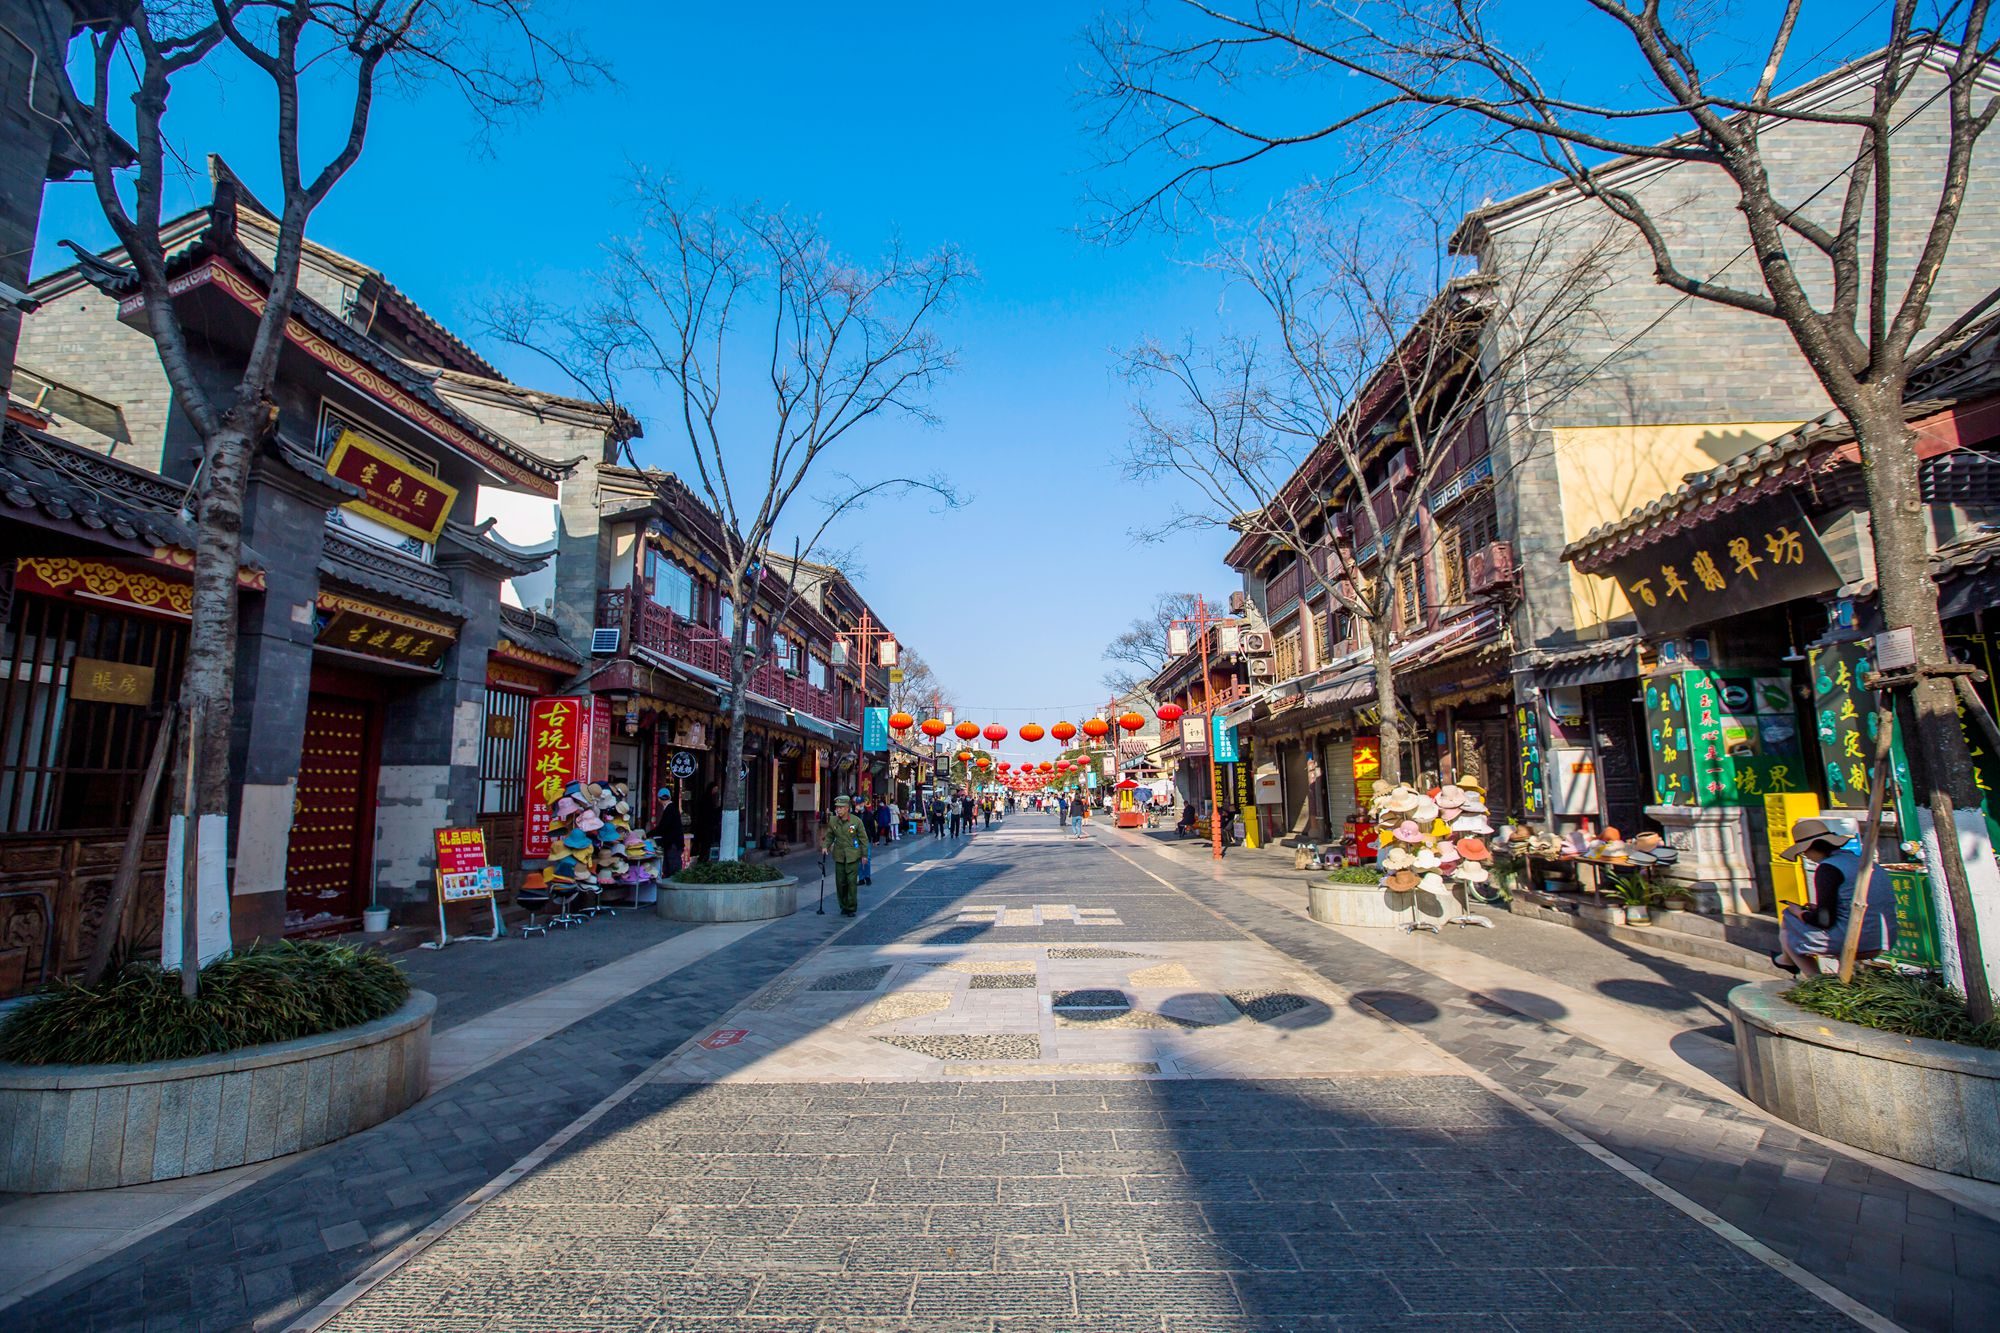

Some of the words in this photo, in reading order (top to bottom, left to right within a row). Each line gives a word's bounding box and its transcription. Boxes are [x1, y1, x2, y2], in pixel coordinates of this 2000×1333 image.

[1630, 526, 1804, 607] 百年翡翠坊
[1660, 692, 1681, 788] 玉石加工
[1835, 660, 1870, 794] 专业定制
[1734, 765, 1797, 795] 境界
[439, 831, 482, 845] 礼品回收
